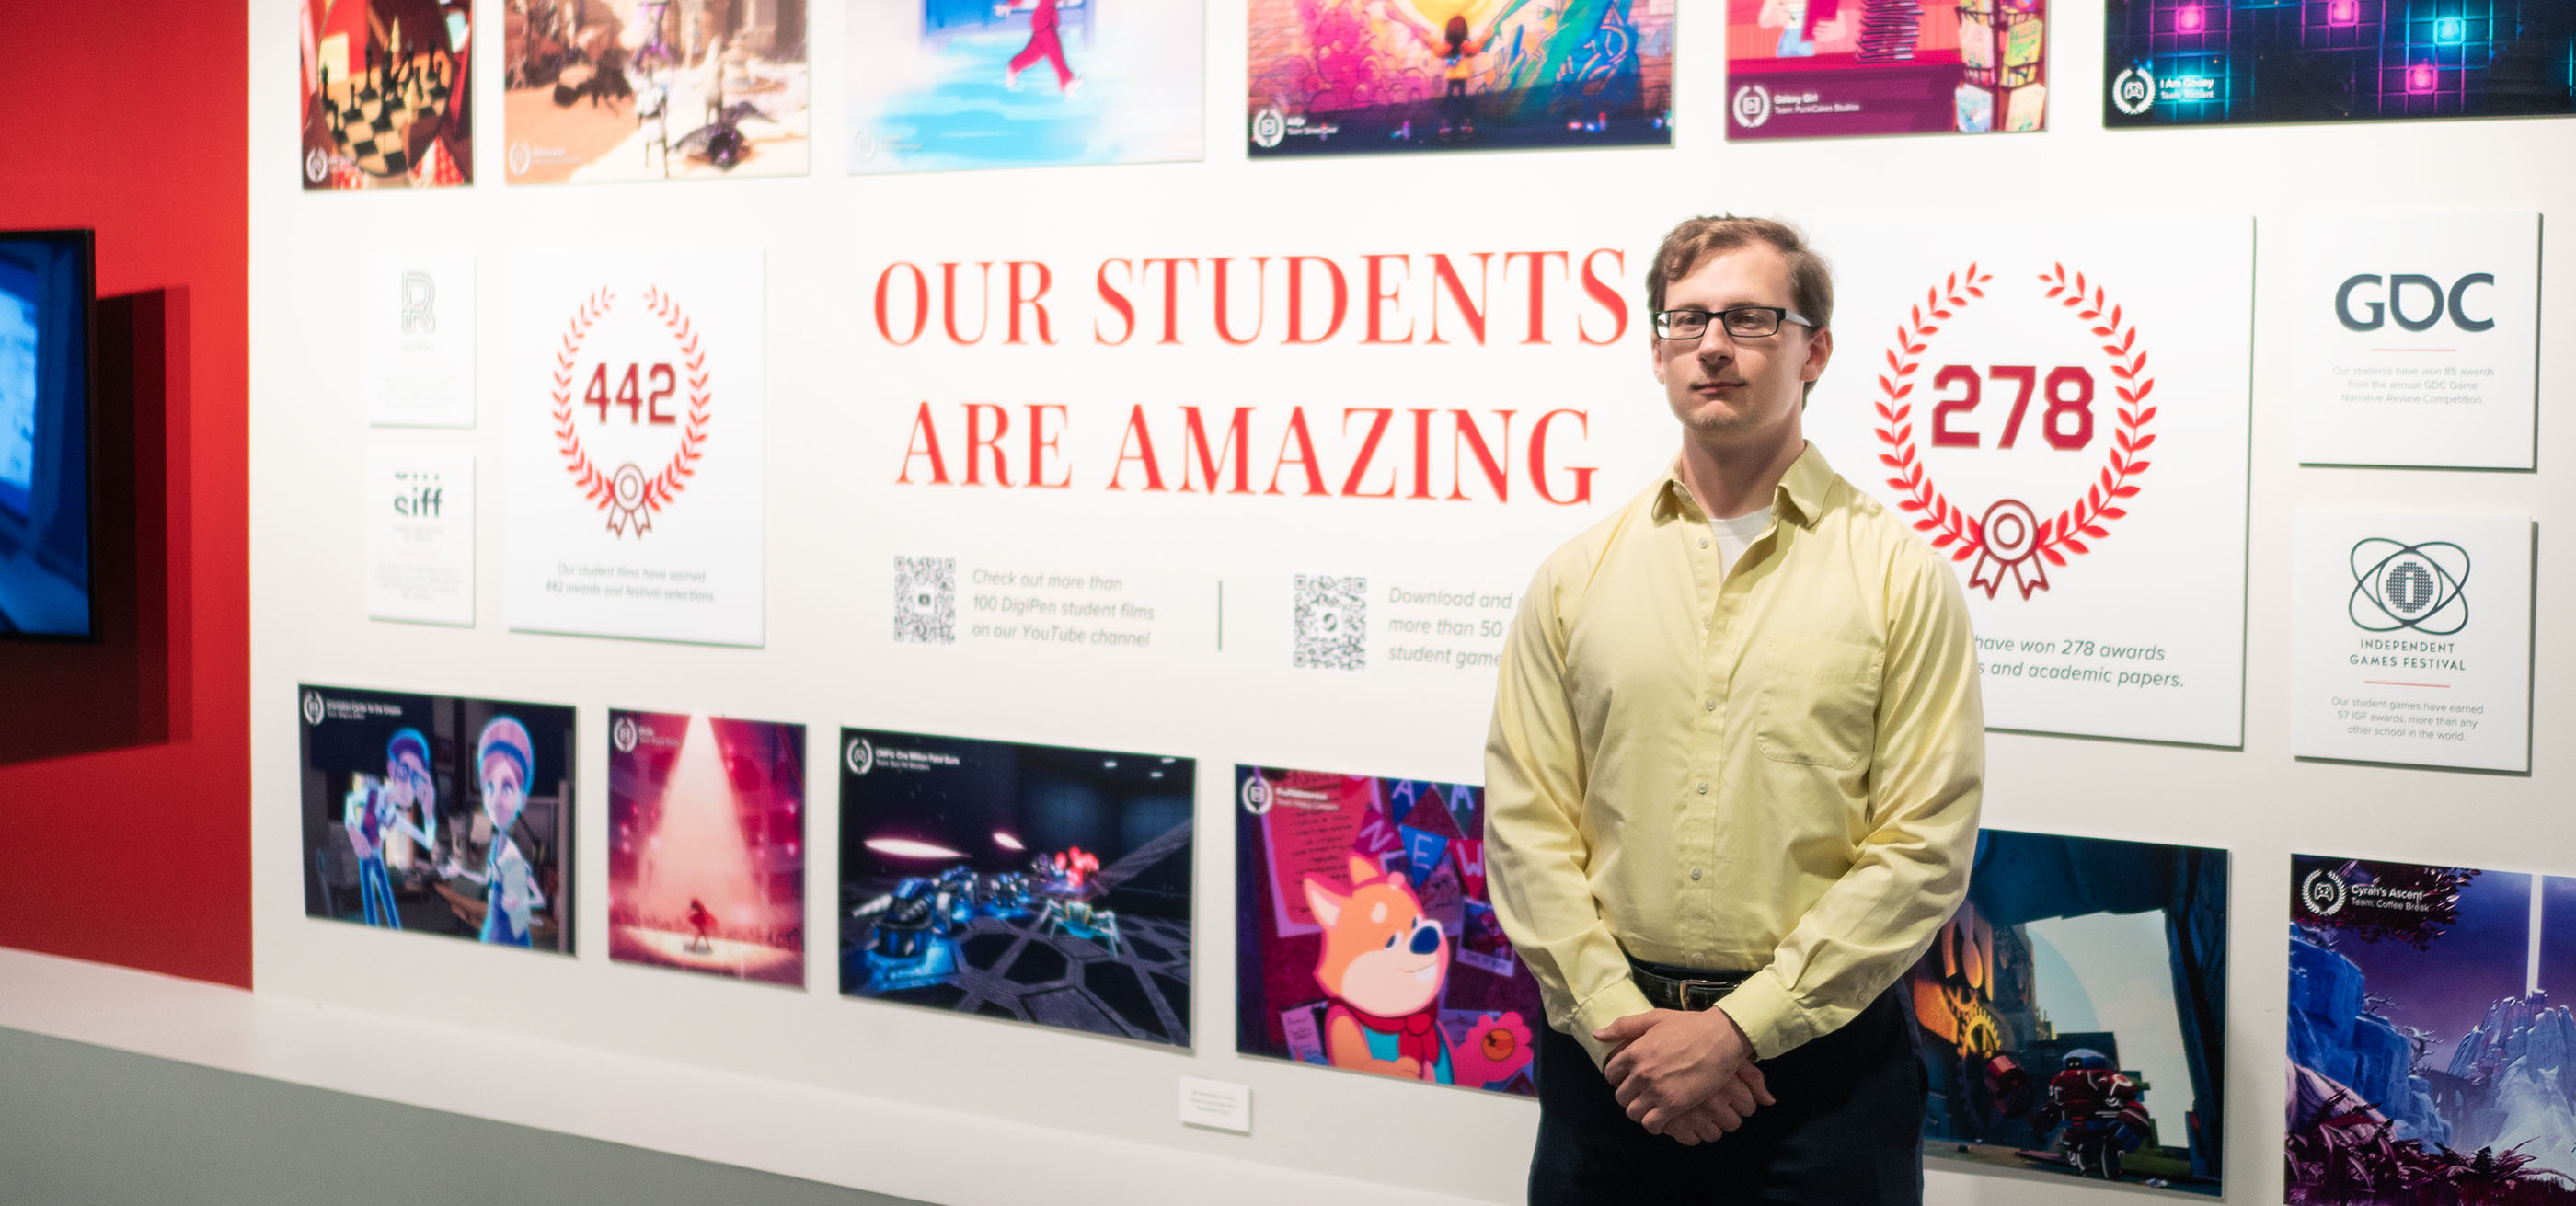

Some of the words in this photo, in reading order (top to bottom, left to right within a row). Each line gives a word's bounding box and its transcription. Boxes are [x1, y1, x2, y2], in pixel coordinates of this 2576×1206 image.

[872, 258, 1061, 347] OUR
[1094, 248, 1630, 347] STUDENTS
[2335, 272, 2495, 333] GDC
[2353, 366, 2393, 377] students
[2396, 367, 2419, 377] have
[2421, 369, 2442, 377] won
[2444, 367, 2457, 377] 85
[2459, 367, 2495, 378] awards
[583, 362, 677, 426] 442
[2348, 380, 2369, 390] from
[2372, 380, 2387, 390] the
[2389, 380, 2421, 390] annual
[2424, 381, 2446, 390] GDC
[2449, 381, 2478, 391] Game
[1931, 364, 2095, 452] 278
[2340, 393, 2384, 404] Narrative
[2386, 394, 2421, 404] Review
[894, 400, 1073, 490] ARE
[1106, 405, 1601, 507] AMAZING
[972, 569, 1017, 587] Check
[1021, 571, 1046, 589] out
[1048, 576, 1085, 591] more
[1090, 575, 1123, 592] than
[972, 595, 998, 612] 100
[1001, 596, 1057, 619] DigiPen
[1061, 600, 1117, 619] student
[1120, 601, 1156, 621] films
[1388, 586, 1475, 608] Download
[1479, 592, 1513, 611] and
[972, 624, 990, 638] on
[994, 625, 1018, 639] our
[1022, 625, 1087, 643] YouTube
[1090, 627, 1151, 648] channel
[1388, 618, 1432, 635] more
[1436, 619, 1474, 637] than
[1479, 620, 1503, 638] 50
[1388, 645, 1452, 664] student
[1974, 634, 2015, 653] have
[2020, 640, 2056, 655] won
[2061, 639, 2096, 657] 278
[2100, 644, 2166, 661] awards
[2360, 638, 2455, 654] INDEPENDENT
[2349, 654, 2398, 668] GAMES
[2402, 657, 2467, 672] FESTIVAL
[1990, 661, 2024, 678] and
[2028, 664, 2113, 683] academic
[2117, 671, 2185, 690] papers.
[2331, 695, 2349, 706] Our
[2352, 697, 2386, 708] student
[2389, 701, 2421, 712] games
[2423, 701, 2447, 712] have
[2449, 704, 2484, 715] earned
[2337, 710, 2348, 720] 57
[2351, 710, 2367, 721] IGF
[2409, 716, 2434, 726] more
[2436, 716, 2457, 728] than
[2460, 718, 2478, 729] any
[2347, 725, 2372, 736] other
[2375, 727, 2406, 738] school
[2408, 728, 2417, 738] in
[2419, 729, 2434, 739] the
[2351, 884, 2386, 898] Cyrah's
[2389, 888, 2423, 901] Ascent
[2351, 896, 2375, 908] Team:
[2376, 899, 2404, 911] Coffee
[2405, 902, 2430, 913] Break
